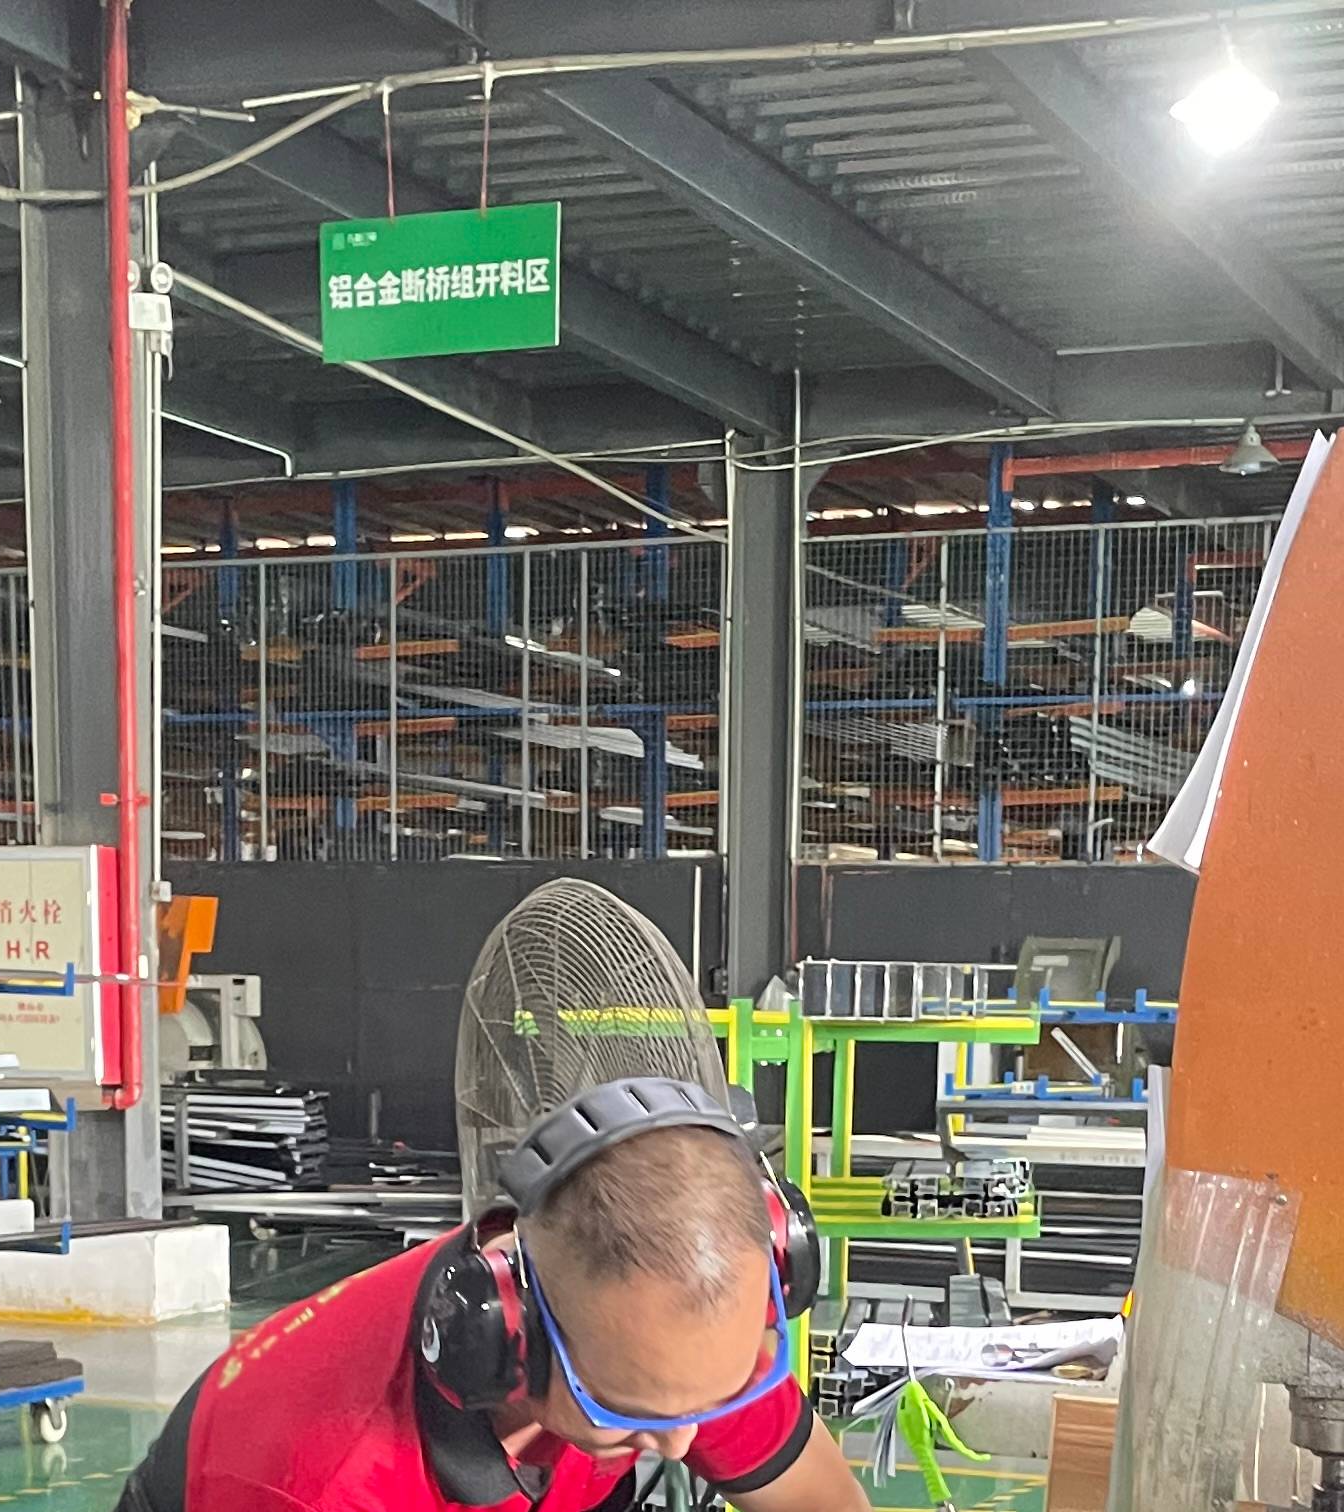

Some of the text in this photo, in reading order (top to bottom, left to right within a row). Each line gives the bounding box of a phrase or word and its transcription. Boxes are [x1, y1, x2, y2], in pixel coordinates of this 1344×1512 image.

[328, 258, 550, 309] 铝合金断桥组开料区
